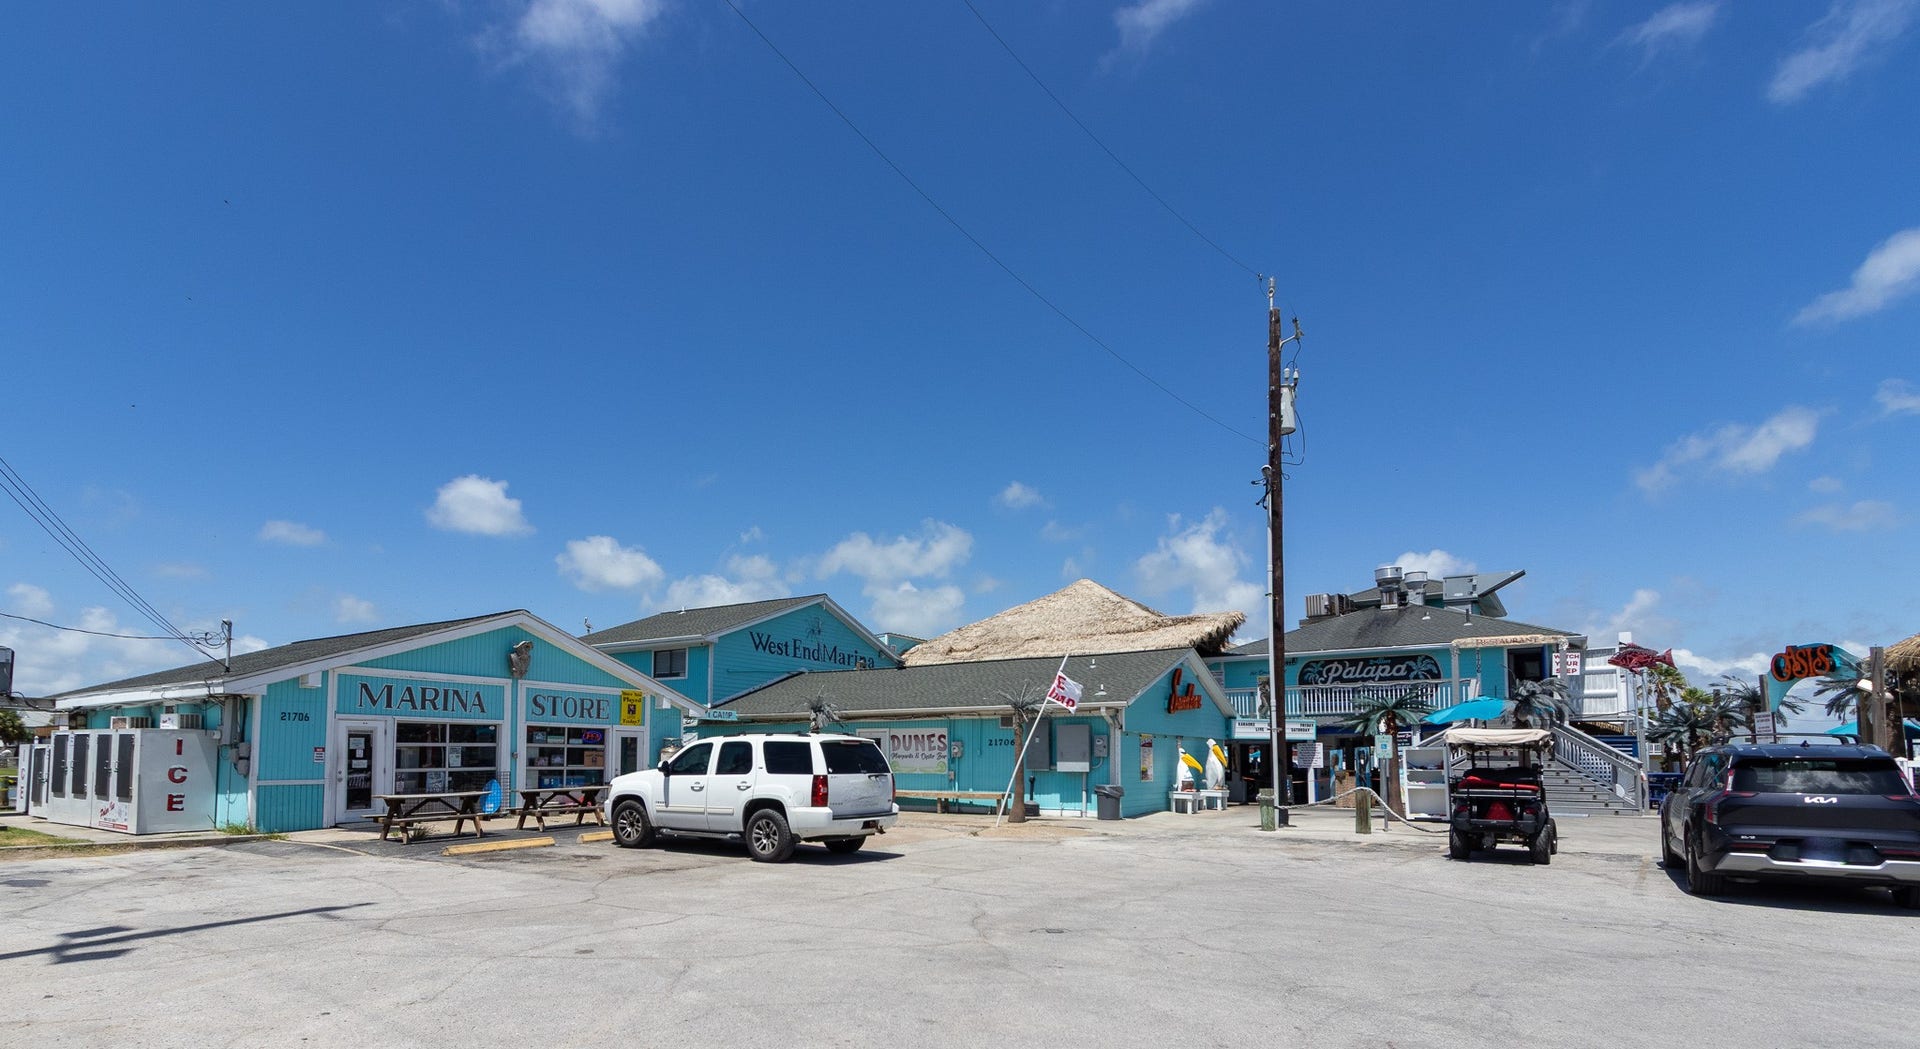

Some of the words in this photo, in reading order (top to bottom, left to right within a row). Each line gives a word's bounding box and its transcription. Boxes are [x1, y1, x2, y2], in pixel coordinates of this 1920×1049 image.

[749, 631, 790, 657] West
[791, 638, 821, 662] End
[822, 643, 875, 669] Marina
[1476, 634, 1539, 647] RESTAURANT
[1318, 661, 1408, 685] Palapa
[1771, 645, 1832, 682] OASIS
[358, 682, 487, 714] MARINA
[531, 694, 610, 720] STORE
[280, 712, 310, 722] 21706
[712, 711, 733, 720] CAMP
[890, 733, 947, 752] DUNES
[988, 738, 1016, 747] 21706
[166, 738, 188, 811] ICE
